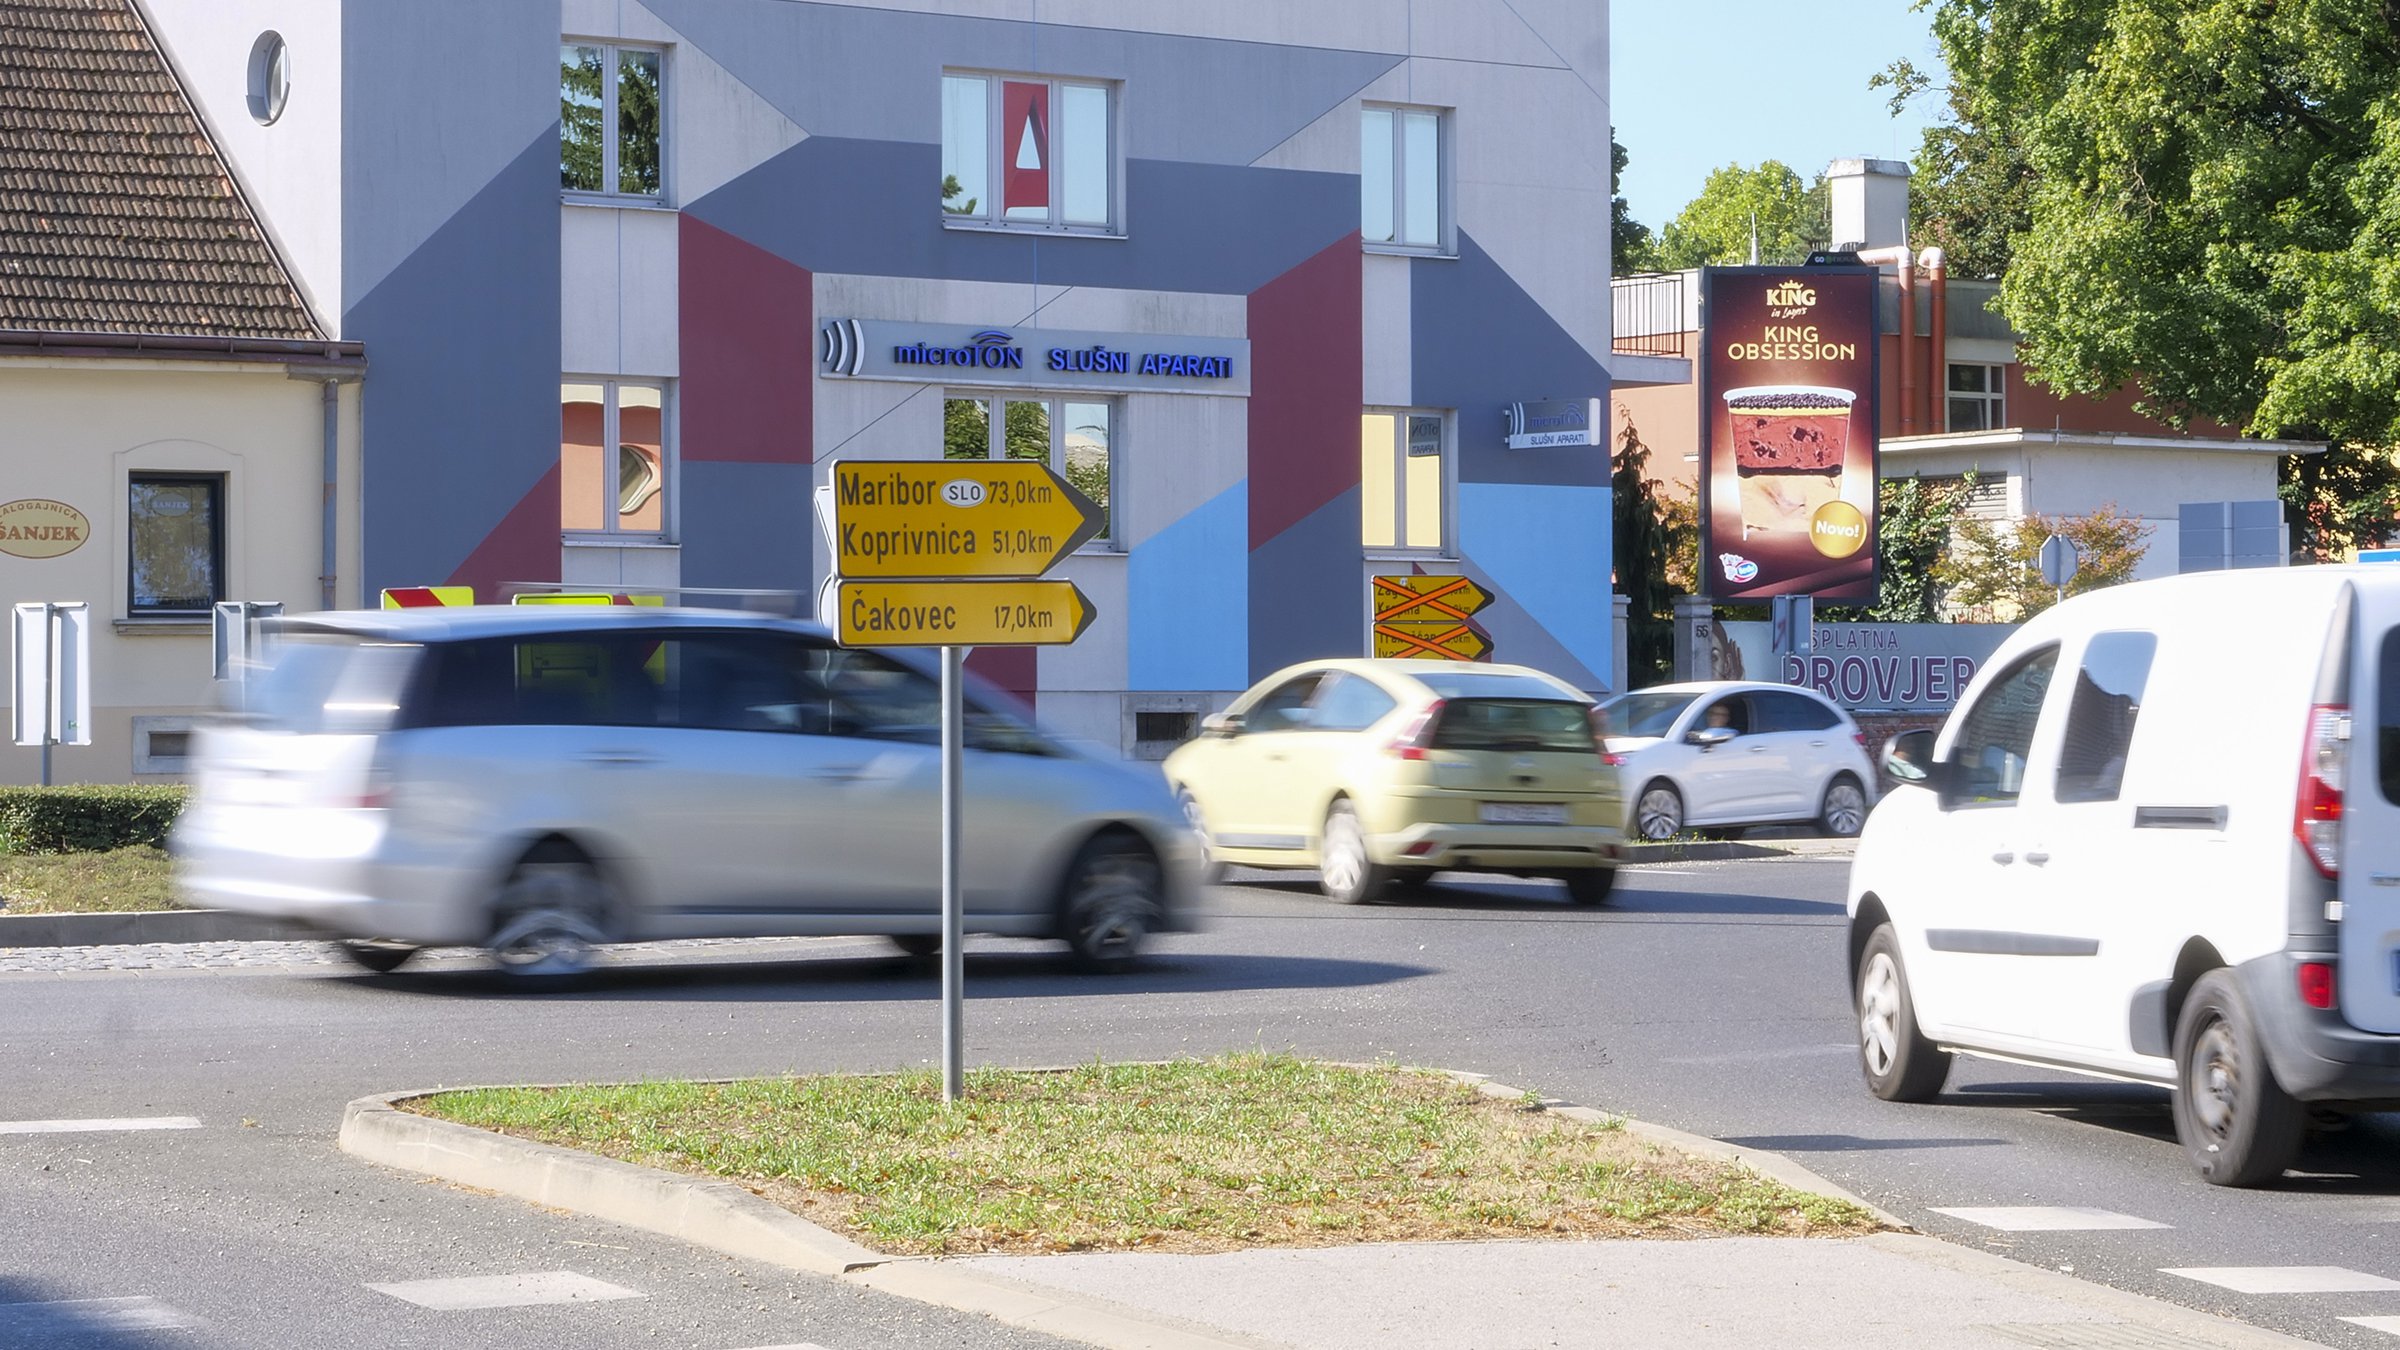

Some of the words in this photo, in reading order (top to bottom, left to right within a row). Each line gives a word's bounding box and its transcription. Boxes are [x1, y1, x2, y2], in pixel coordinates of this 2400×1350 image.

[1766, 289, 1816, 306] KING
[1771, 308, 1781, 317] in
[1765, 326, 1819, 343] KING
[895, 342, 1023, 368] microTON
[1048, 345, 1130, 373] SLUŠNI
[1138, 353, 1233, 378] APARATI
[1728, 343, 1855, 360] OBSESSION
[1530, 433, 1554, 445] SLUŠNI
[1556, 434, 1584, 444] APARATI
[841, 472, 937, 505] Maribor
[949, 485, 981, 500] SLO
[989, 480, 1051, 507] 73,0km
[0, 502, 78, 520] ALOGAJNICA
[1816, 520, 1860, 538] Novo!
[843, 523, 976, 564] Koprivnica
[993, 529, 1052, 557] 51,0km
[852, 590, 956, 632] Čakovec
[995, 605, 1052, 632] 17,0km
[1812, 630, 1899, 649] SPLATNA
[1782, 656, 1979, 703] PROVJER
